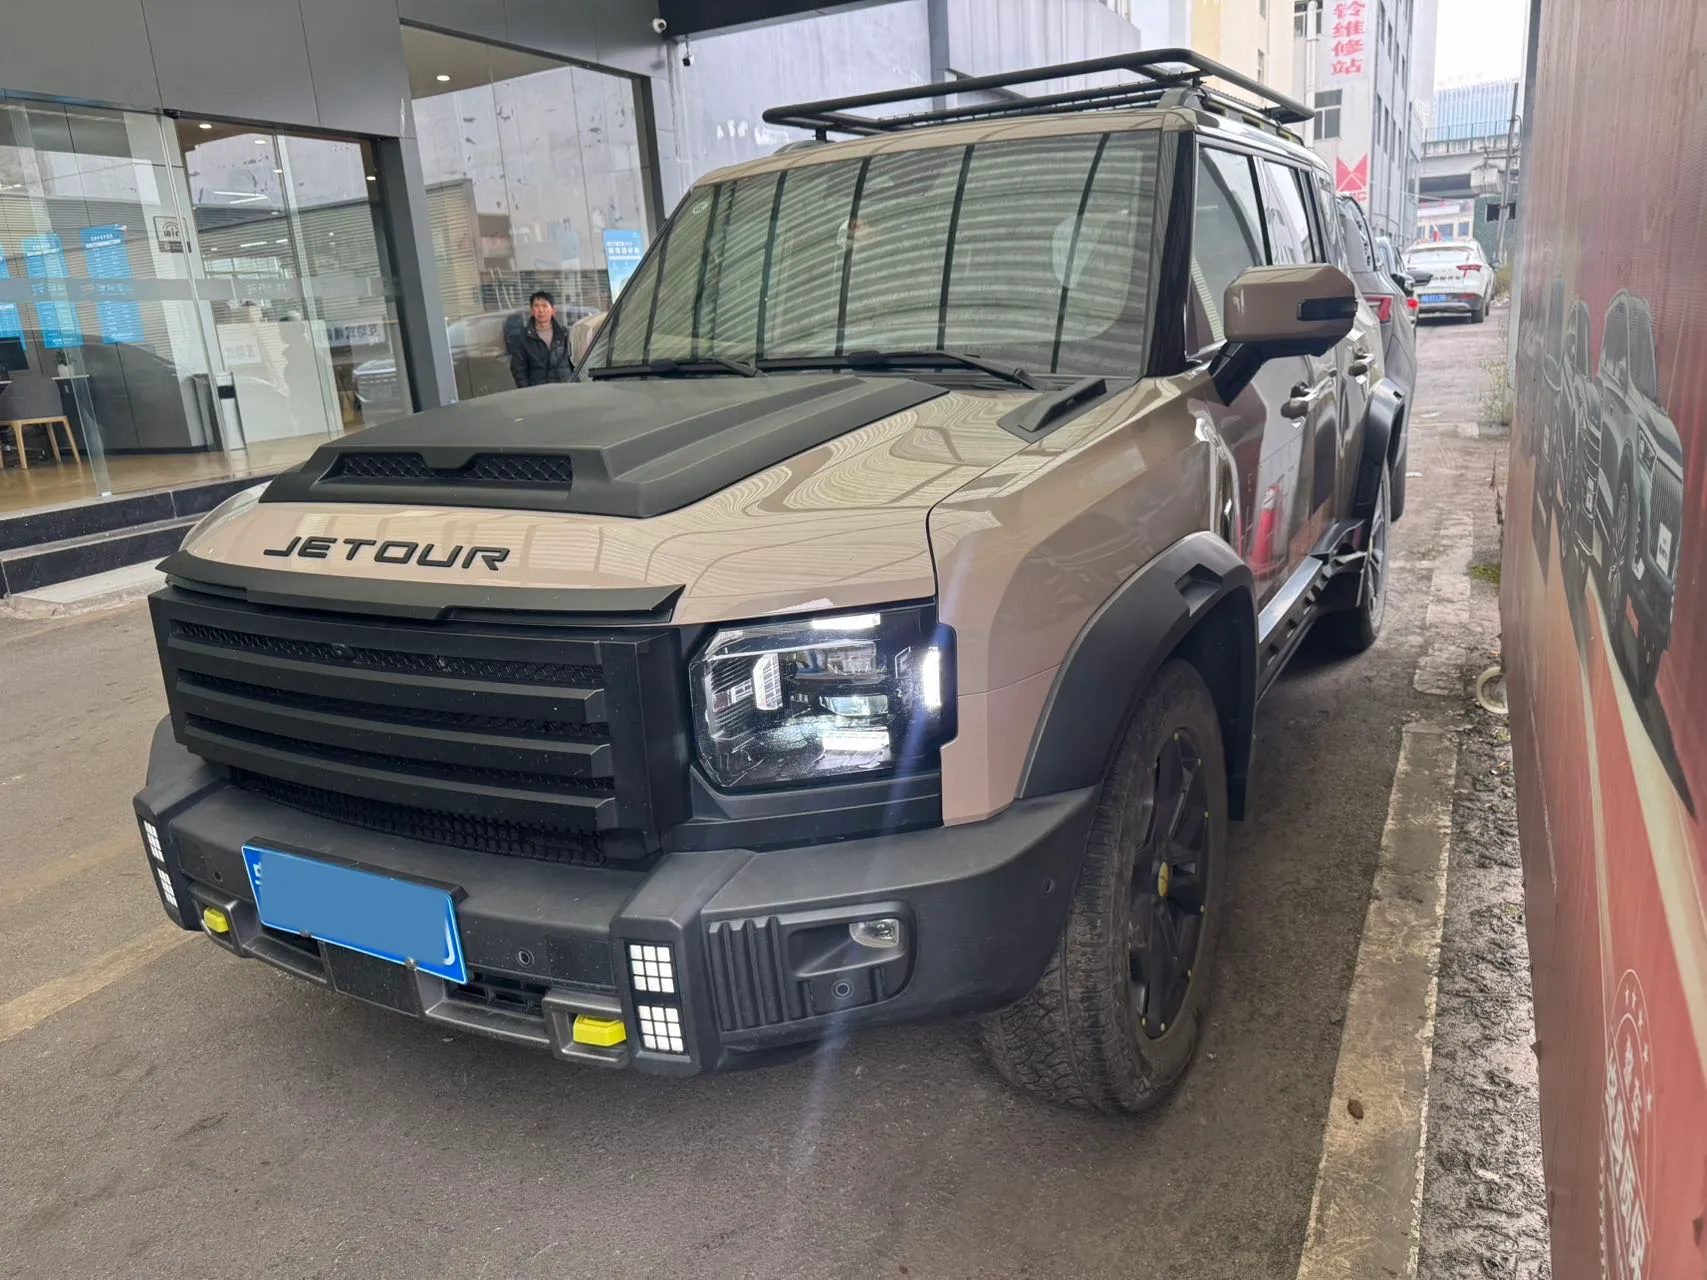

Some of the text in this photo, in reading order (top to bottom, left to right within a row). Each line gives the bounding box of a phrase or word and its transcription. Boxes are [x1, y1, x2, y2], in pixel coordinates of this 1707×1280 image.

[1331, 1, 1366, 76] 铃维修站
[263, 536, 510, 571] JETOUR
